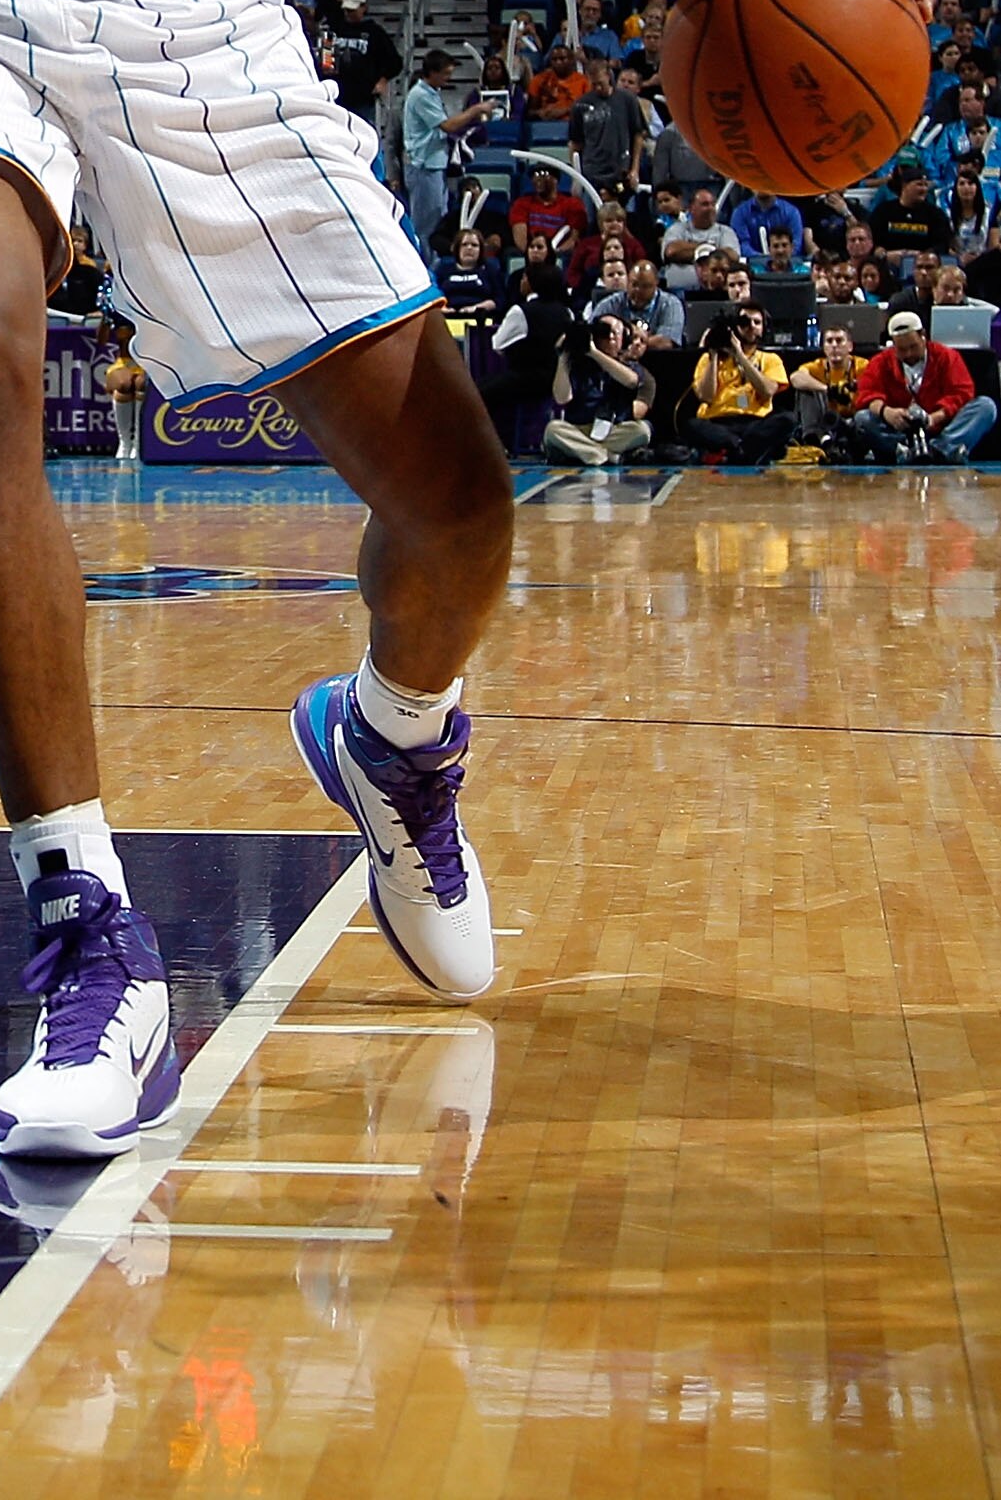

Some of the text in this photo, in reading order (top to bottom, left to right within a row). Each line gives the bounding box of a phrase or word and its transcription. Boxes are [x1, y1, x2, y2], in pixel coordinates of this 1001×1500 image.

[153, 401, 246, 446] Crown
[394, 705, 420, 719] 30
[41, 893, 81, 926] NIKE
